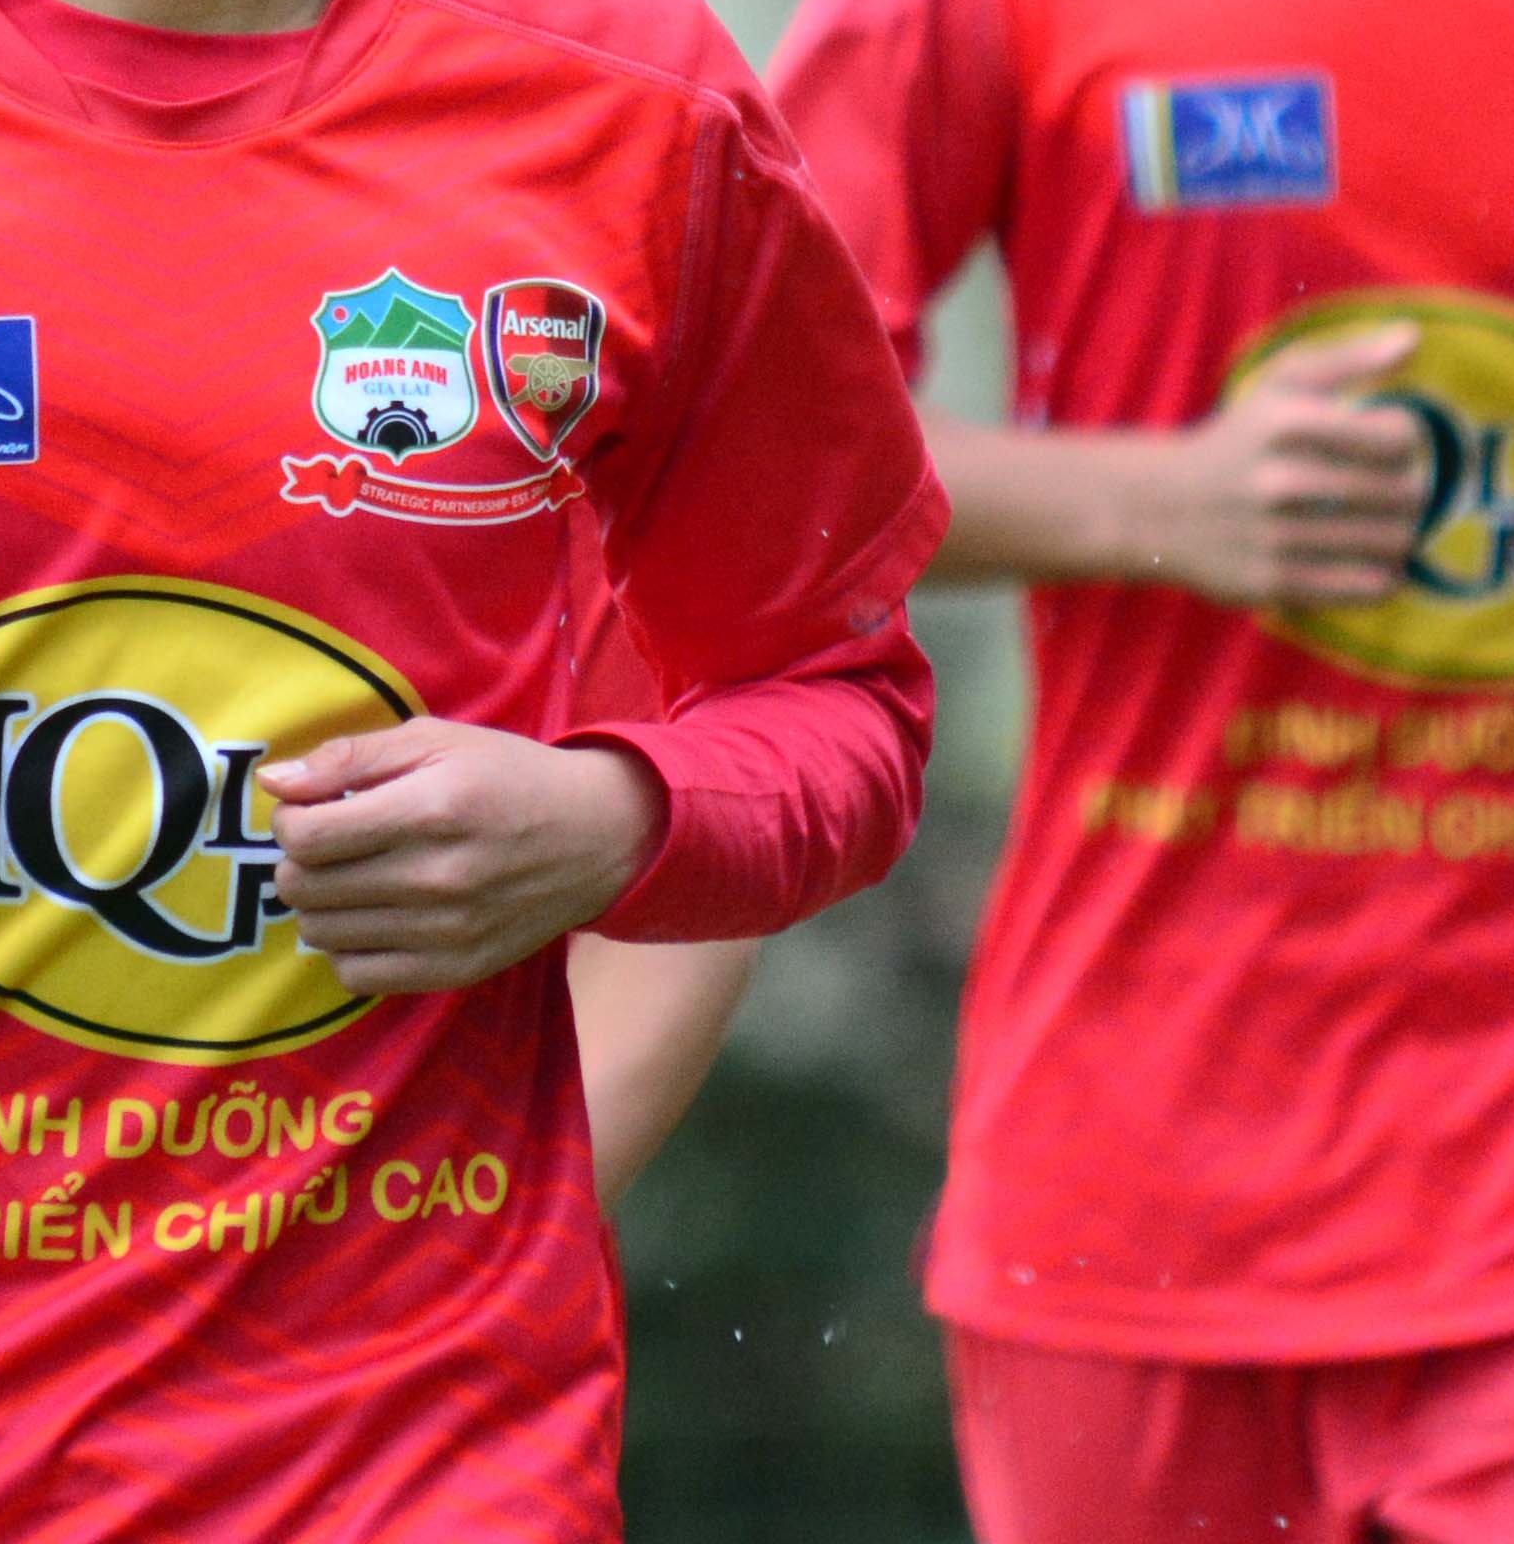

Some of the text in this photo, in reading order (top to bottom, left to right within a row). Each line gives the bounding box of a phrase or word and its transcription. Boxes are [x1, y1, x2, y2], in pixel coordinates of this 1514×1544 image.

[503, 310, 585, 340] Arsenal
[411, 360, 447, 385] ANH
[363, 381, 431, 397] GIA LAI
[360, 482, 430, 511] STRATEGIC
[432, 496, 508, 513] PARTNERSHIP
[370, 1151, 509, 1223] CAO
